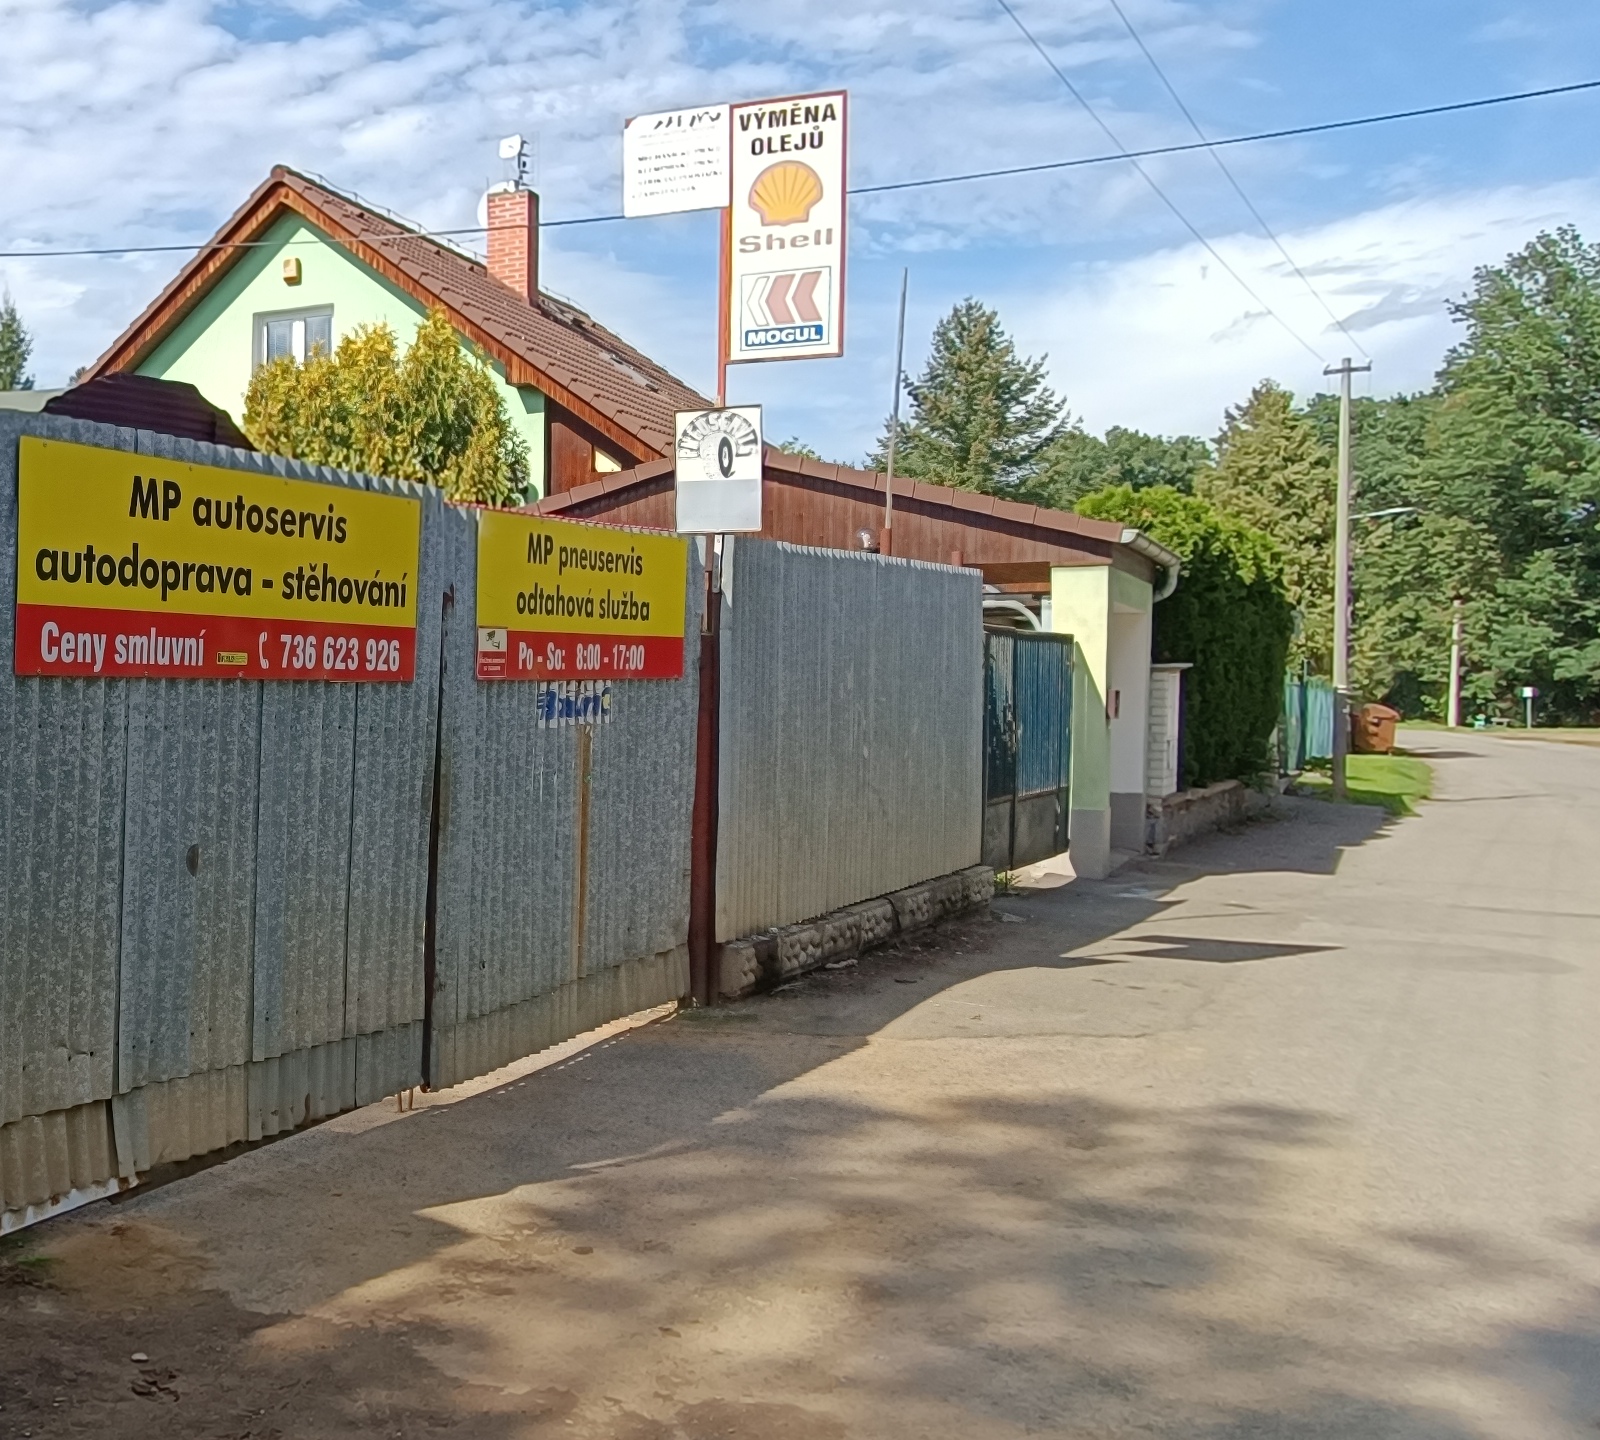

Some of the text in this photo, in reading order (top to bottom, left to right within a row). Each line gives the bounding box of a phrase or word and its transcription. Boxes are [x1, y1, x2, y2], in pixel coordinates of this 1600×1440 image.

[738, 103, 837, 132] VÝMĚNA
[750, 125, 824, 156] OLEJŮ
[739, 228, 833, 254] Shell
[747, 327, 822, 346] MOGUL
[128, 475, 348, 544] MP autoservis
[527, 532, 643, 576] MP pneuservis
[35, 542, 252, 601] autodoprava
[281, 563, 408, 609] stěhování
[516, 582, 650, 621] odtahová služba
[40, 621, 206, 673] Ceny smluvní
[280, 634, 400, 672] 736 623 926
[518, 641, 533, 670] Po
[546, 642, 566, 671] So:
[576, 643, 601, 671] 8:00
[612, 644, 645, 671] 17:00
